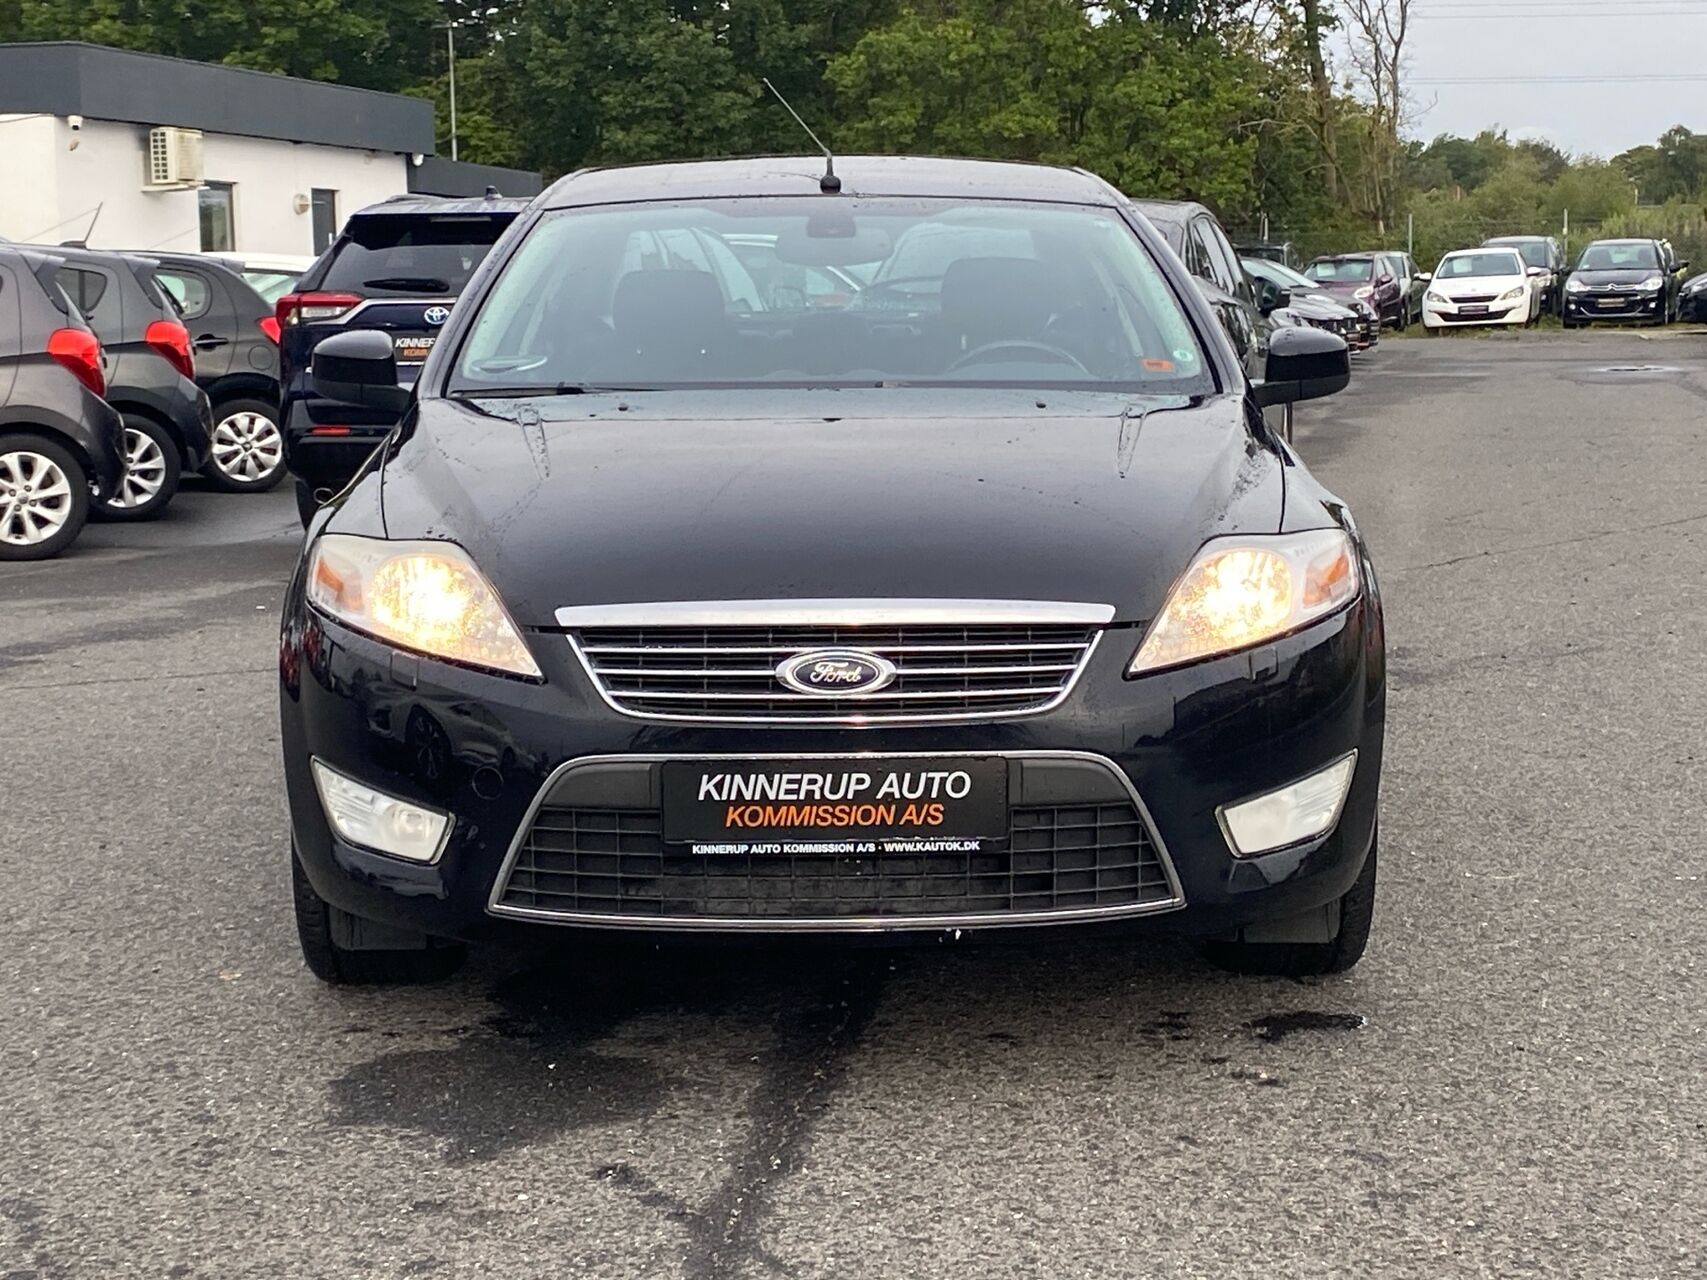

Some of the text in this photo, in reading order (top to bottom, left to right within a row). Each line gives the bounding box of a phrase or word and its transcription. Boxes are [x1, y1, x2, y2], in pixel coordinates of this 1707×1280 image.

[810, 661, 862, 683] Ford
[698, 771, 971, 801] KINNERUP AUTO
[725, 803, 945, 827] KOMMISSION A/S
[692, 841, 980, 854] KINNERUP AUTO KOMMISSION A/S WWW.KAUTOK.DK
